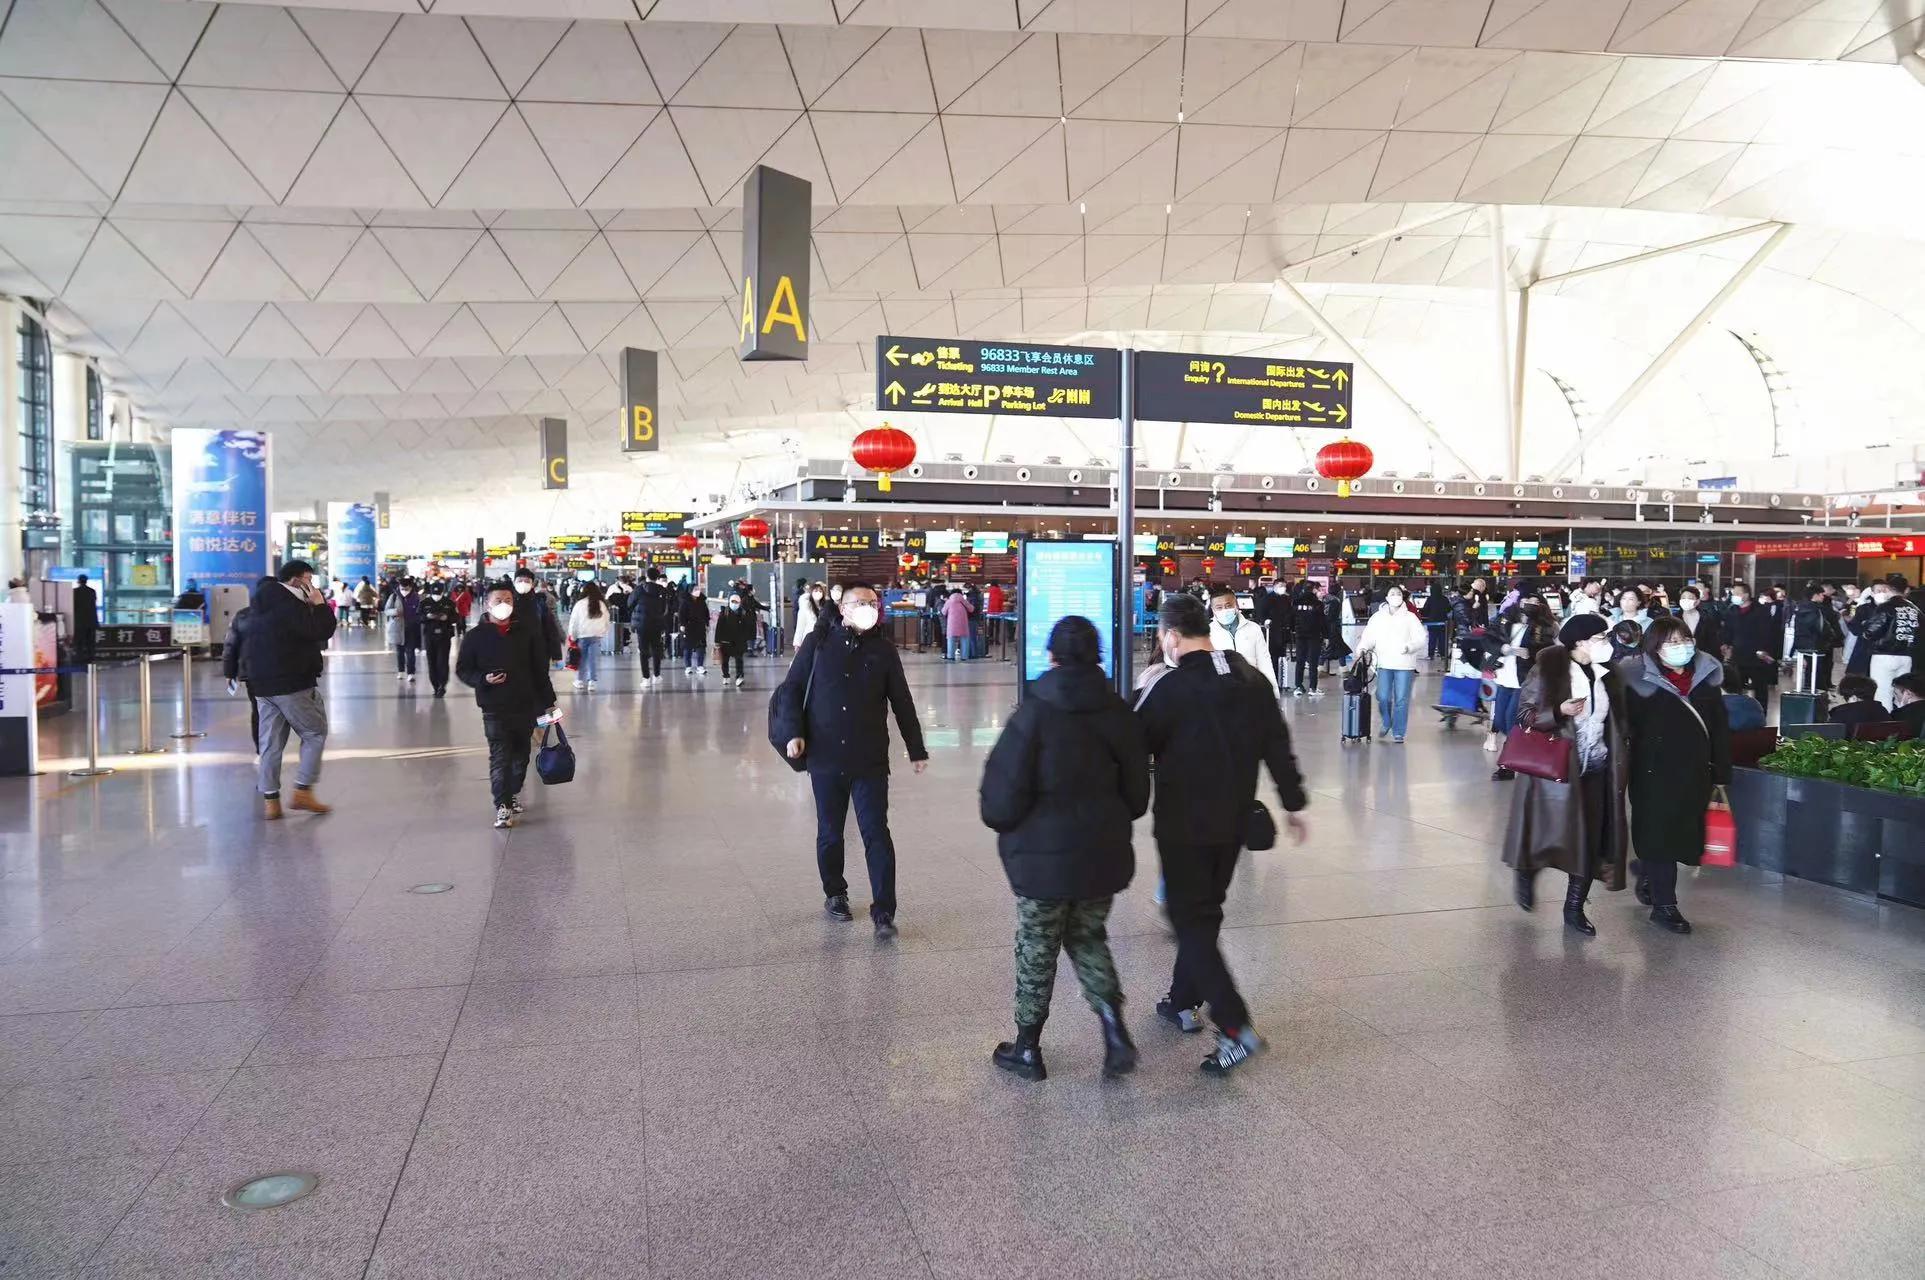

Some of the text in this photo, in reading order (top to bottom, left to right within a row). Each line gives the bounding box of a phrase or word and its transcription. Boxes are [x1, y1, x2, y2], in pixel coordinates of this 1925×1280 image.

[761, 275, 807, 343] A
[980, 363, 1078, 376] 96833 Member Rest Area
[1266, 365, 1305, 378] 国际出发
[1184, 374, 1210, 384] Enquiry
[1227, 377, 1305, 389] International Departures
[1001, 385, 1035, 399] 停车场
[937, 397, 964, 407] Arrival
[1001, 400, 1046, 411] Parking Lot
[1262, 398, 1301, 411] 国内出发
[1234, 411, 1302, 422] Domestic Departures
[633, 404, 654, 442] B
[550, 457, 566, 483] C
[816, 535, 828, 549] A
[907, 538, 925, 547] A01
[1157, 541, 1175, 551] A04
[1209, 542, 1225, 551] A05
[1294, 544, 1310, 553] A06
[1343, 544, 1358, 553] A07
[1422, 545, 1436, 555] A08
[1464, 546, 1479, 555] A09
[1538, 546, 1551, 555] A10
